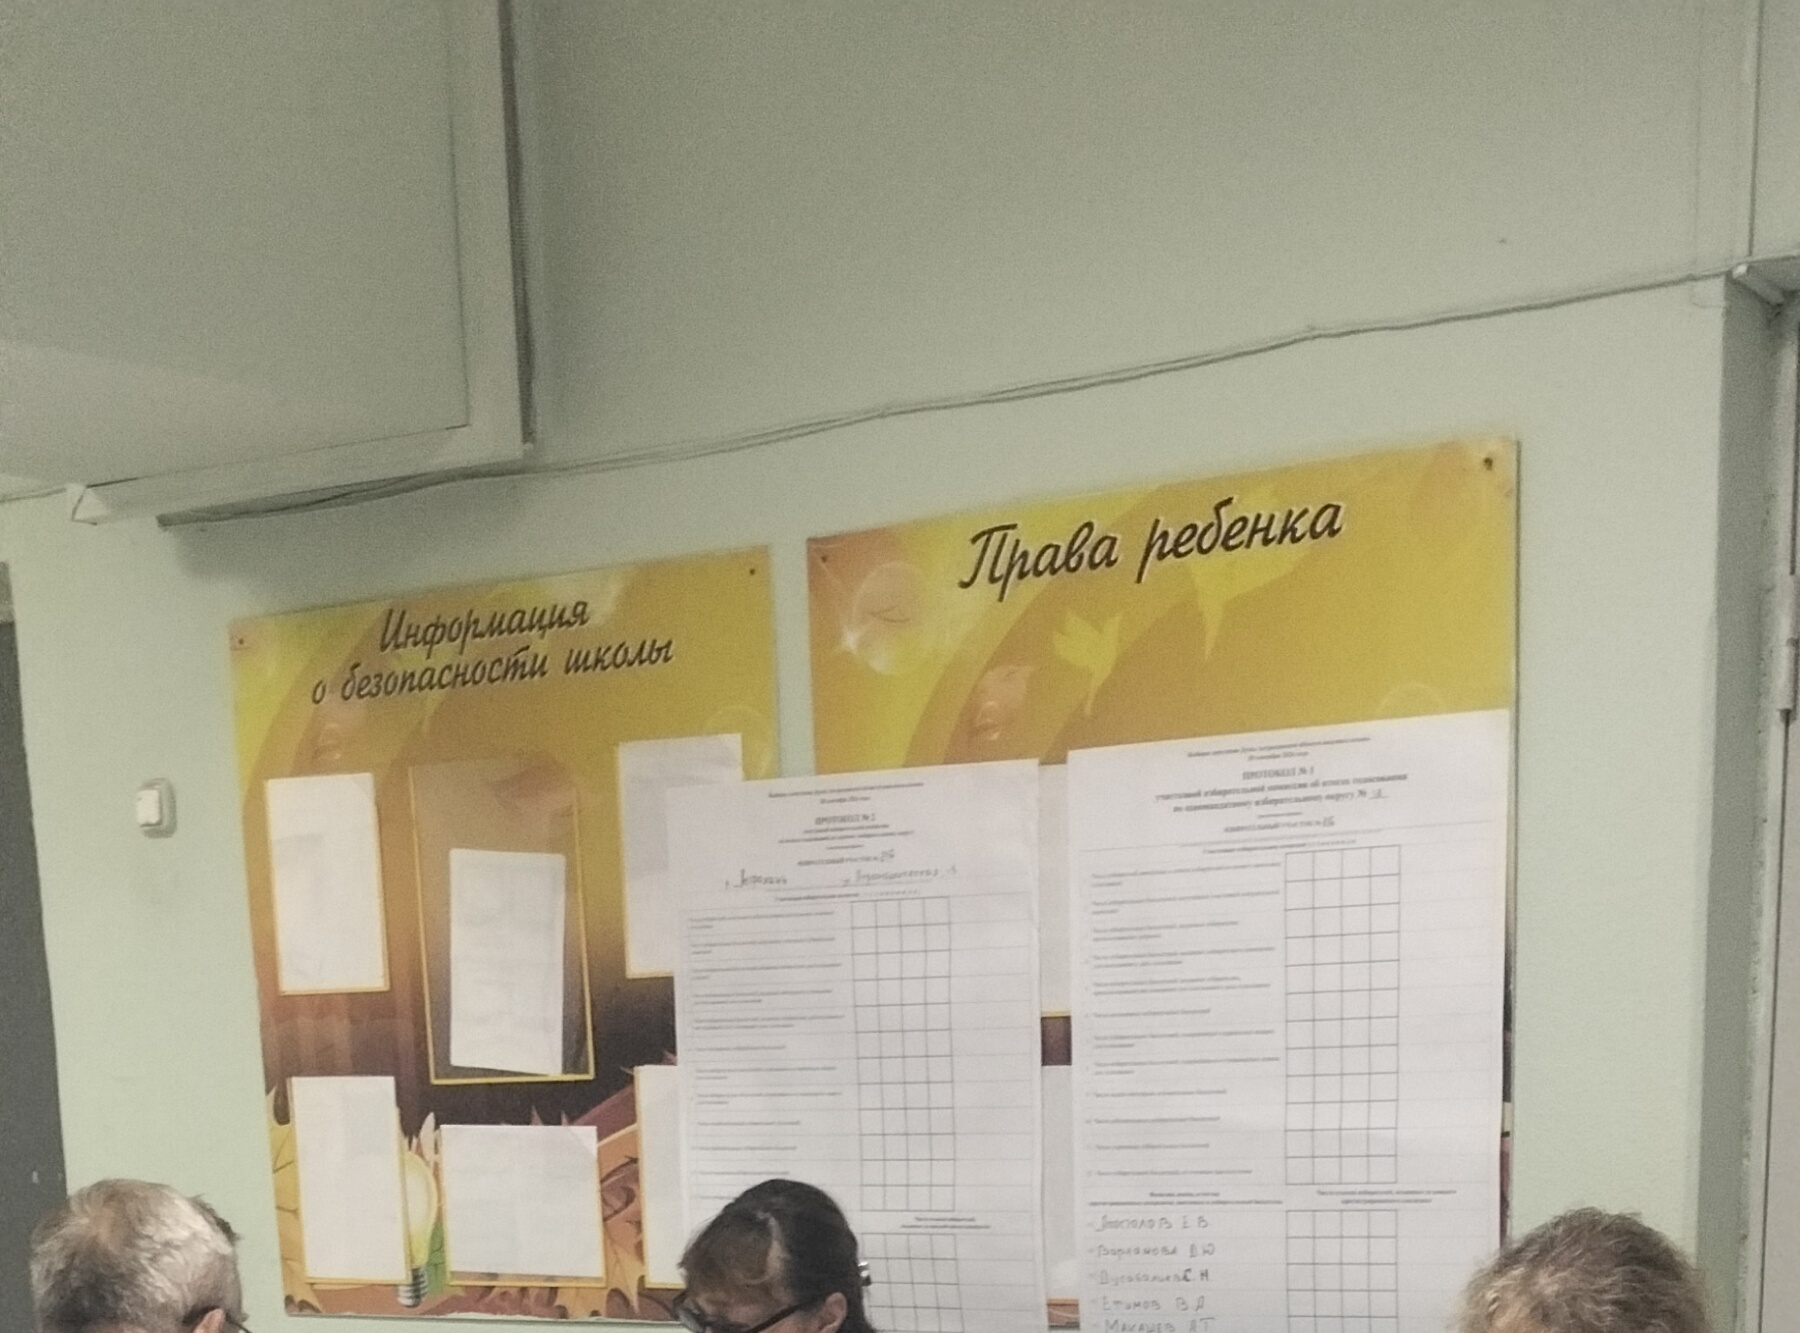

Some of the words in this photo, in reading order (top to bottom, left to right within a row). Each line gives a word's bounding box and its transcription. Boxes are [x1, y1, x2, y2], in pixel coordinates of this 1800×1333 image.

[957, 521, 1120, 603] Права
[1134, 496, 1344, 585] ребенка
[380, 600, 590, 658] Информация
[312, 680, 327, 705] о
[341, 645, 550, 701] безопасности
[564, 638, 674, 676] школы
